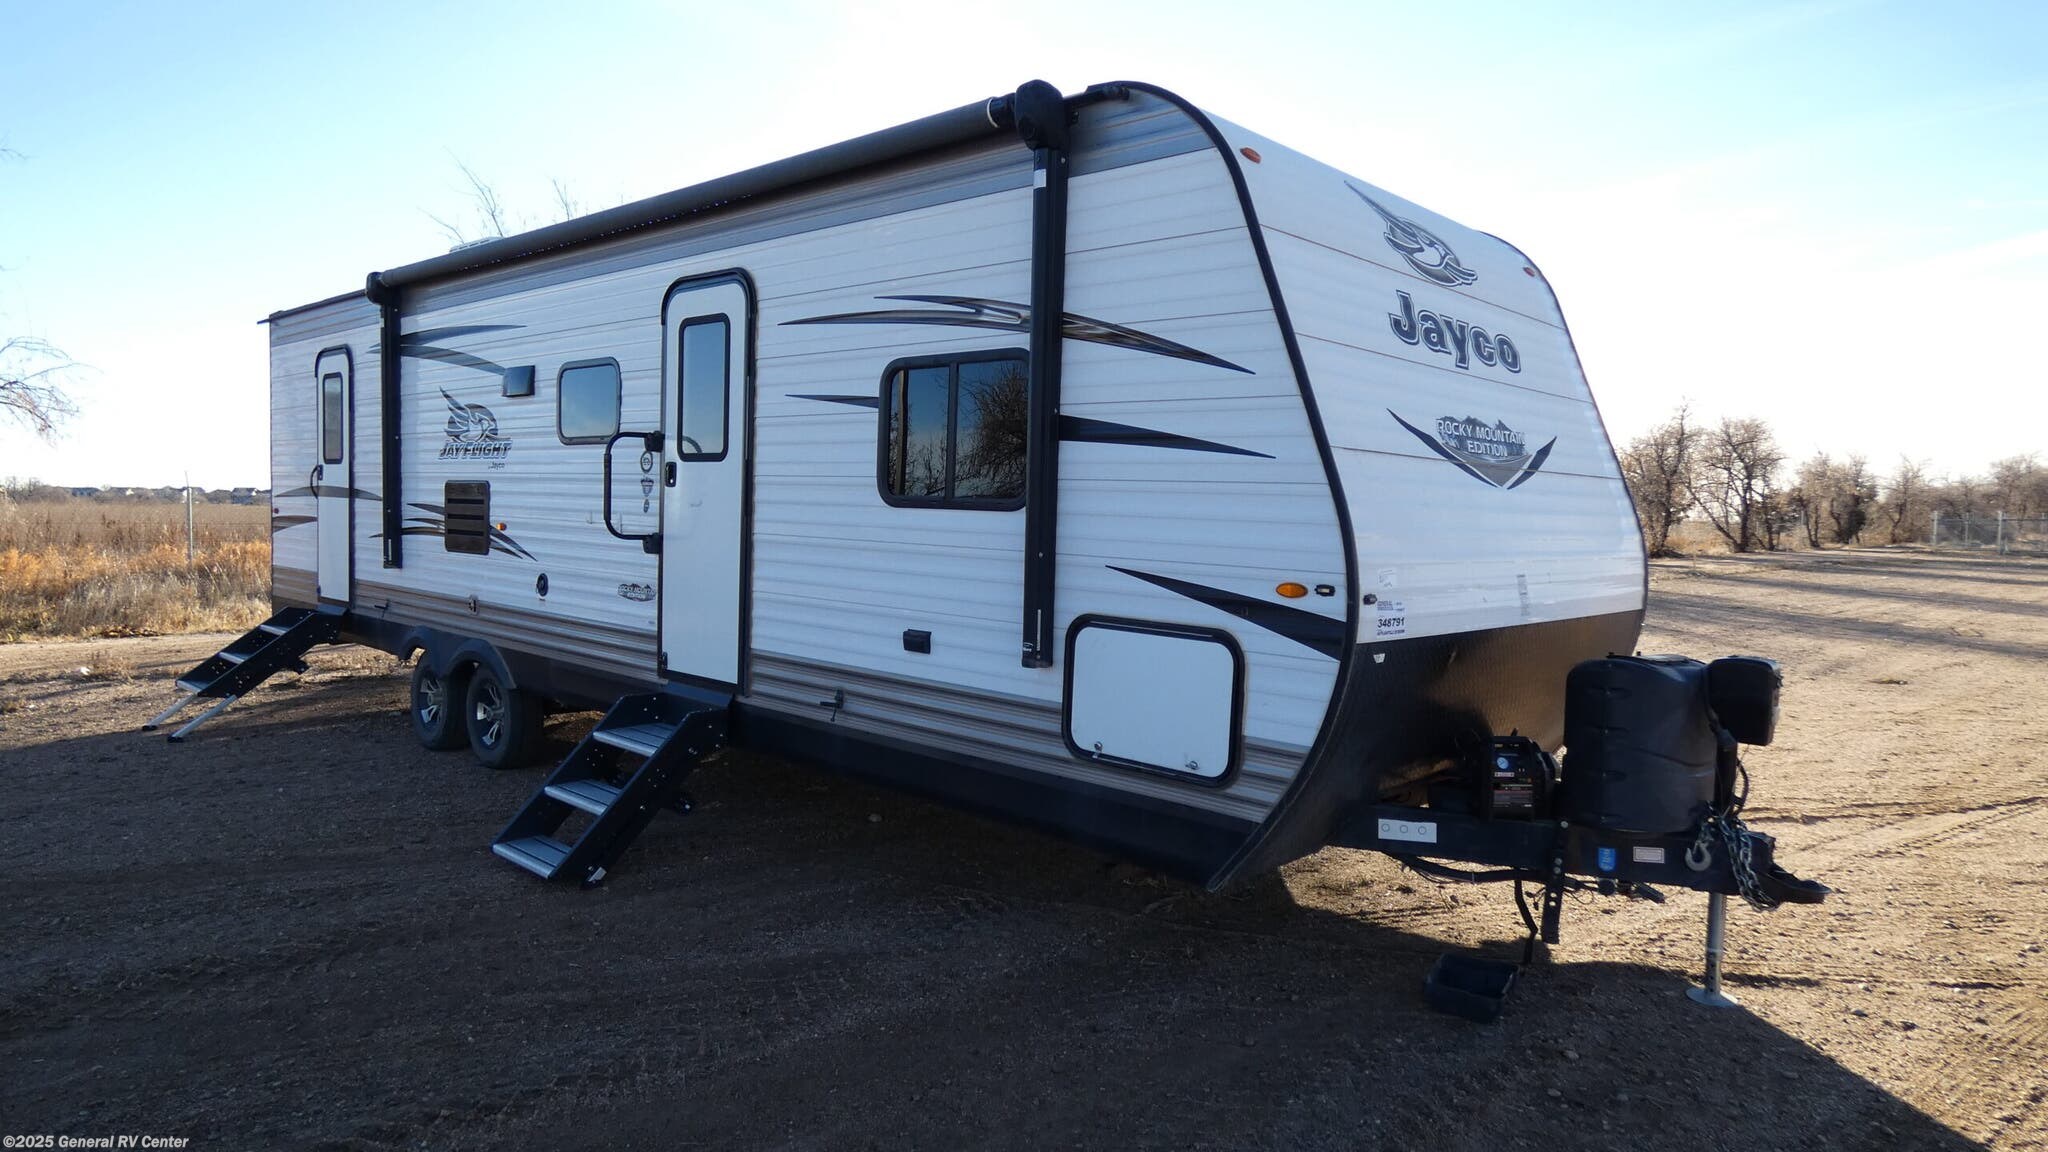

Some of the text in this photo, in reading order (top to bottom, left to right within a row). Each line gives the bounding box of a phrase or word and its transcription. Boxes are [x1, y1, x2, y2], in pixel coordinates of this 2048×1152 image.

[1388, 290, 1521, 373] Jayco
[1437, 420, 1525, 444] ROCKY MOUNTAIN
[1467, 440, 1508, 457] EDITION
[1377, 617, 1405, 628] 348791
